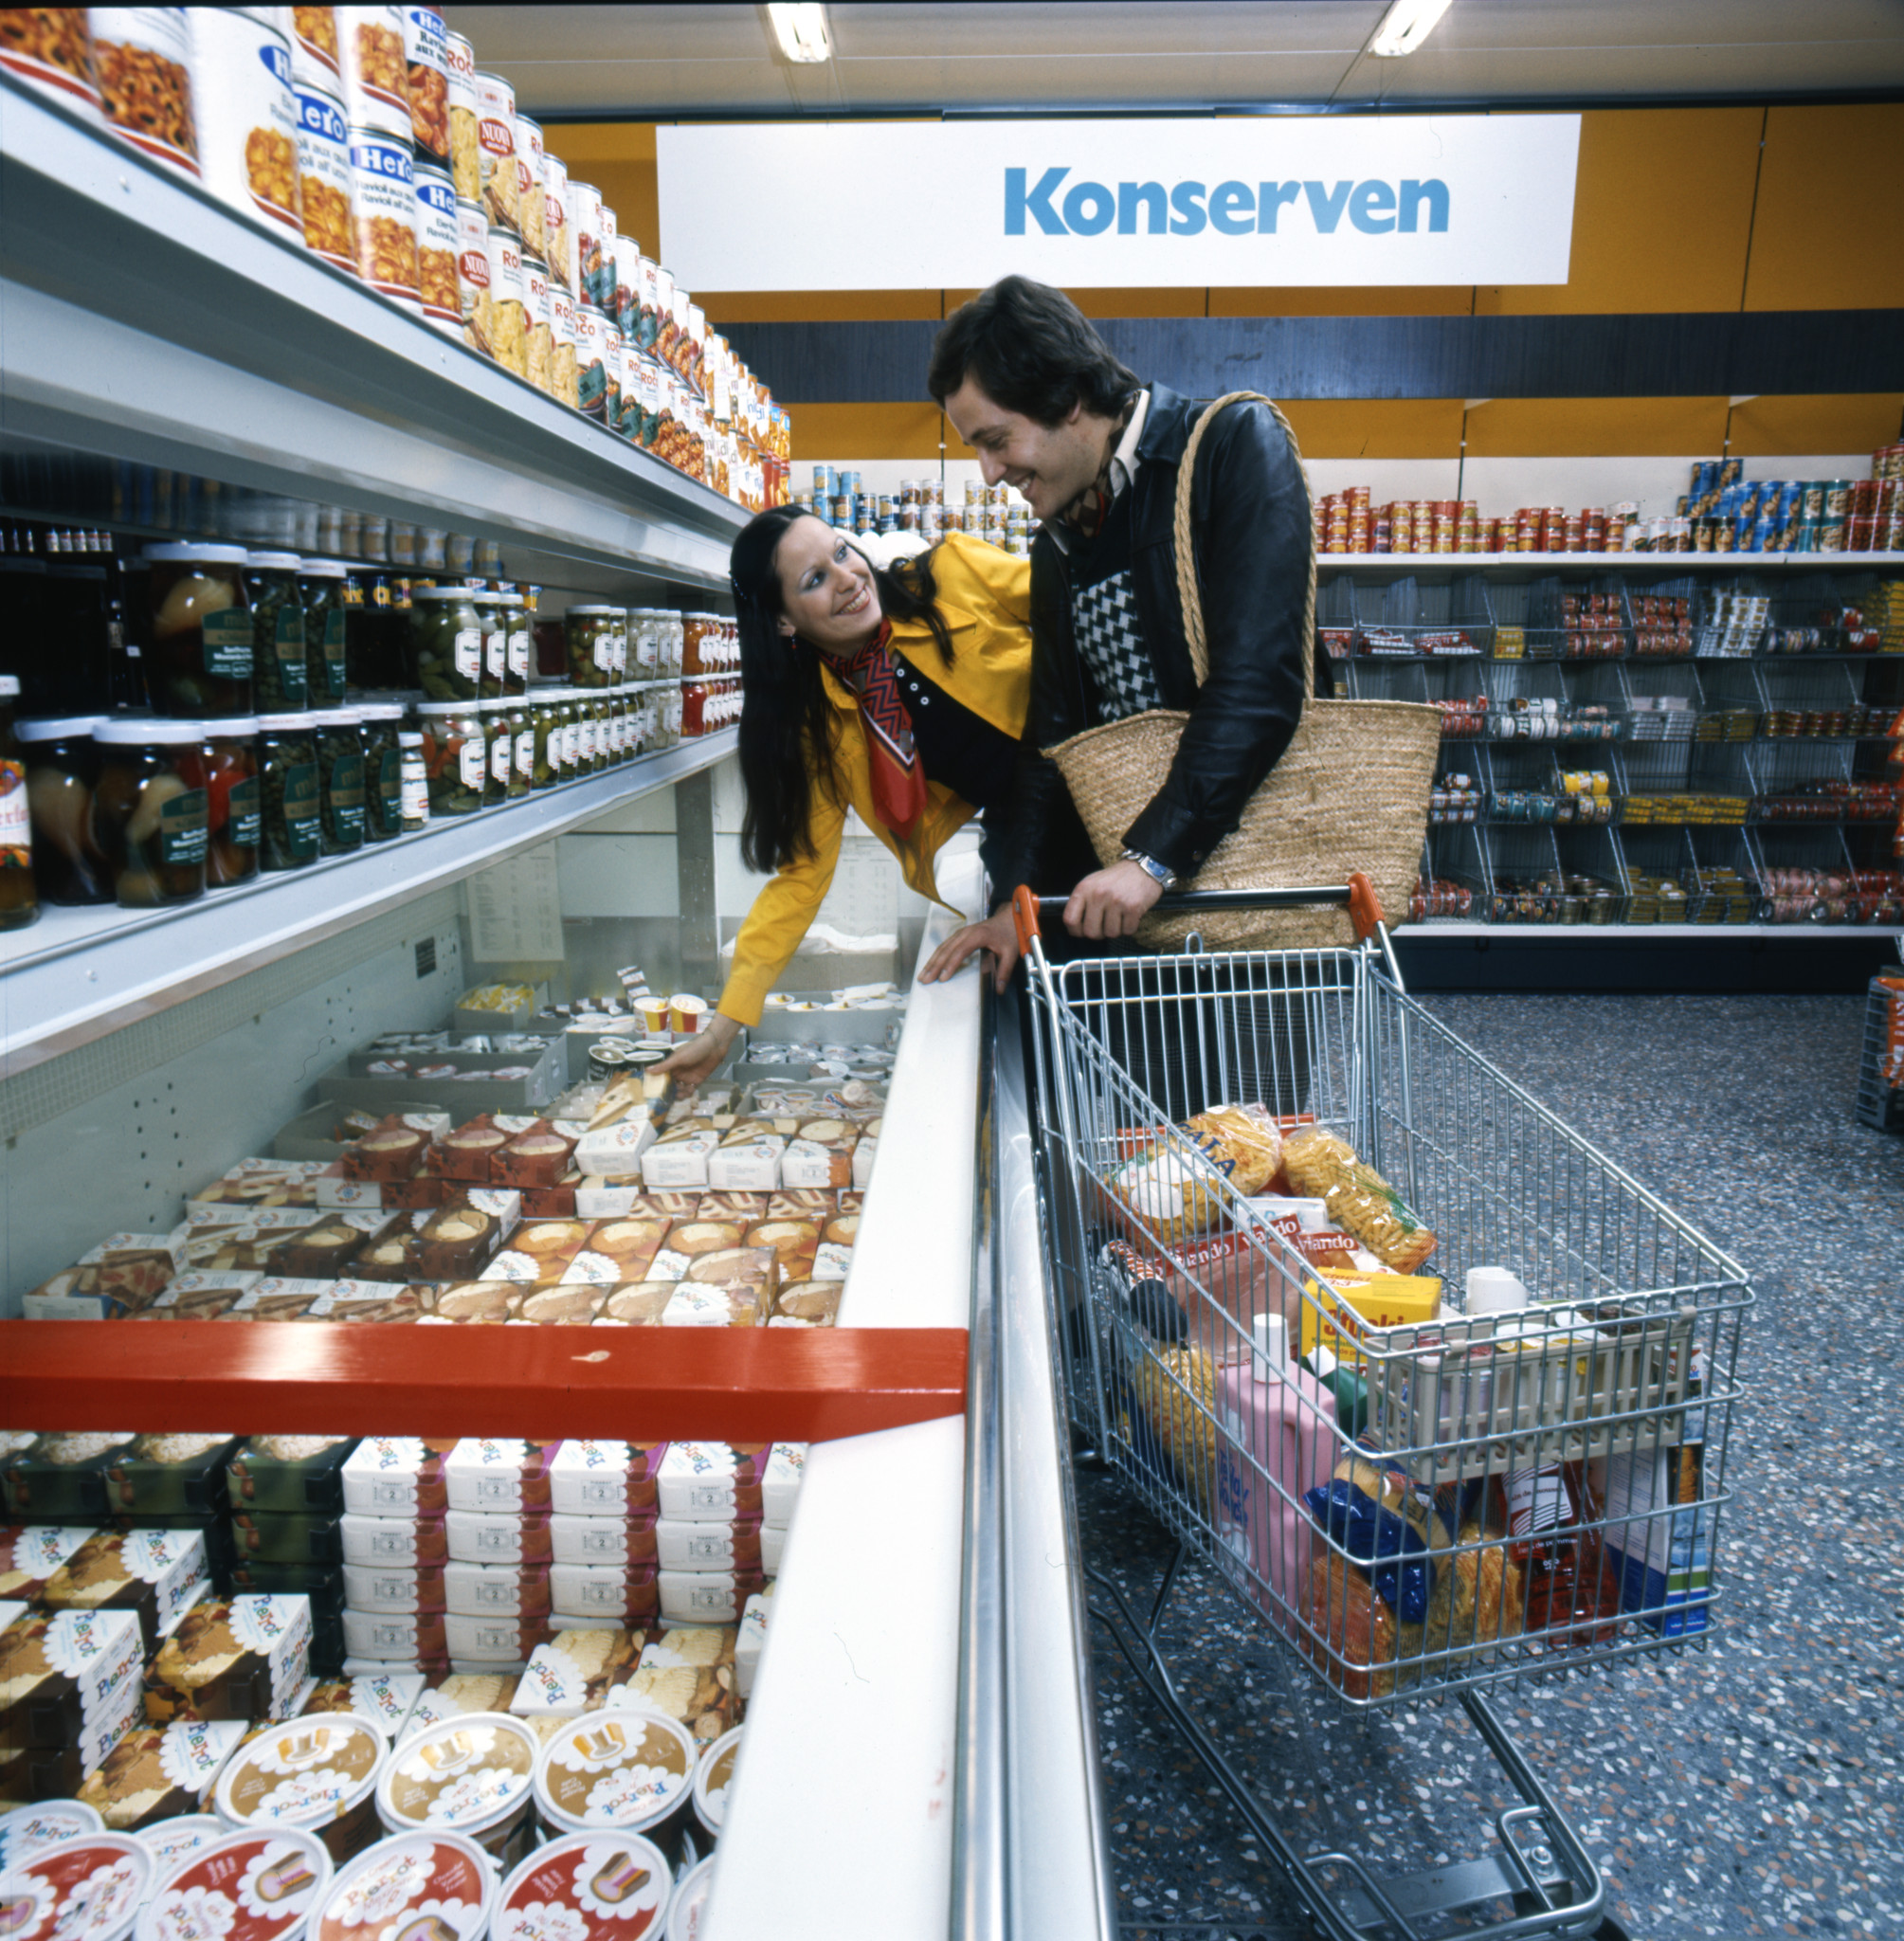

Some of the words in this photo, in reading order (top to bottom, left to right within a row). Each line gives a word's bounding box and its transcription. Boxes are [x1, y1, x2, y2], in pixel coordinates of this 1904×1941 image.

[361, 148, 412, 183] Hero
[429, 185, 455, 213] He
[1004, 166, 1450, 237] Konserven
[1242, 1219, 1297, 1247] viado
[1297, 1236, 1355, 1251] viando
[372, 1437, 399, 1470] Pierr
[479, 1438, 501, 1464] Pierr
[580, 1440, 606, 1468] Pierr
[671, 1441, 712, 1475] Pierro
[390, 1490, 395, 1498] 2
[494, 1485, 499, 1495] 2
[598, 1489, 604, 1497] 2
[707, 1495, 713, 1503] 2
[40, 1527, 67, 1564] Pierrot
[147, 1530, 175, 1567] Pierrot
[389, 1540, 394, 1550] 2
[494, 1536, 499, 1545] 2
[599, 1539, 605, 1548] 2
[705, 1544, 712, 1552] 2
[169, 1555, 207, 1607] Pierrot
[390, 1587, 396, 1595] 2
[492, 1590, 499, 1600] 2
[598, 1590, 604, 1599] 2
[707, 1596, 714, 1605] 2
[253, 1594, 284, 1638] Pierrot
[73, 1610, 101, 1658] Pierrot
[390, 1632, 395, 1641] 2
[493, 1636, 499, 1644] 2
[96, 1639, 142, 1702] Pierrot
[526, 1660, 567, 1706] Pierrot
[372, 1675, 406, 1718] Pierrot
[98, 1695, 143, 1757] Pierro
[188, 1720, 219, 1771] Pierrot
[271, 1787, 342, 1817] Pierrot
[444, 1782, 512, 1820] Pierrot
[602, 1781, 668, 1816] Pierrot
[346, 1854, 418, 1907] Pierrot
